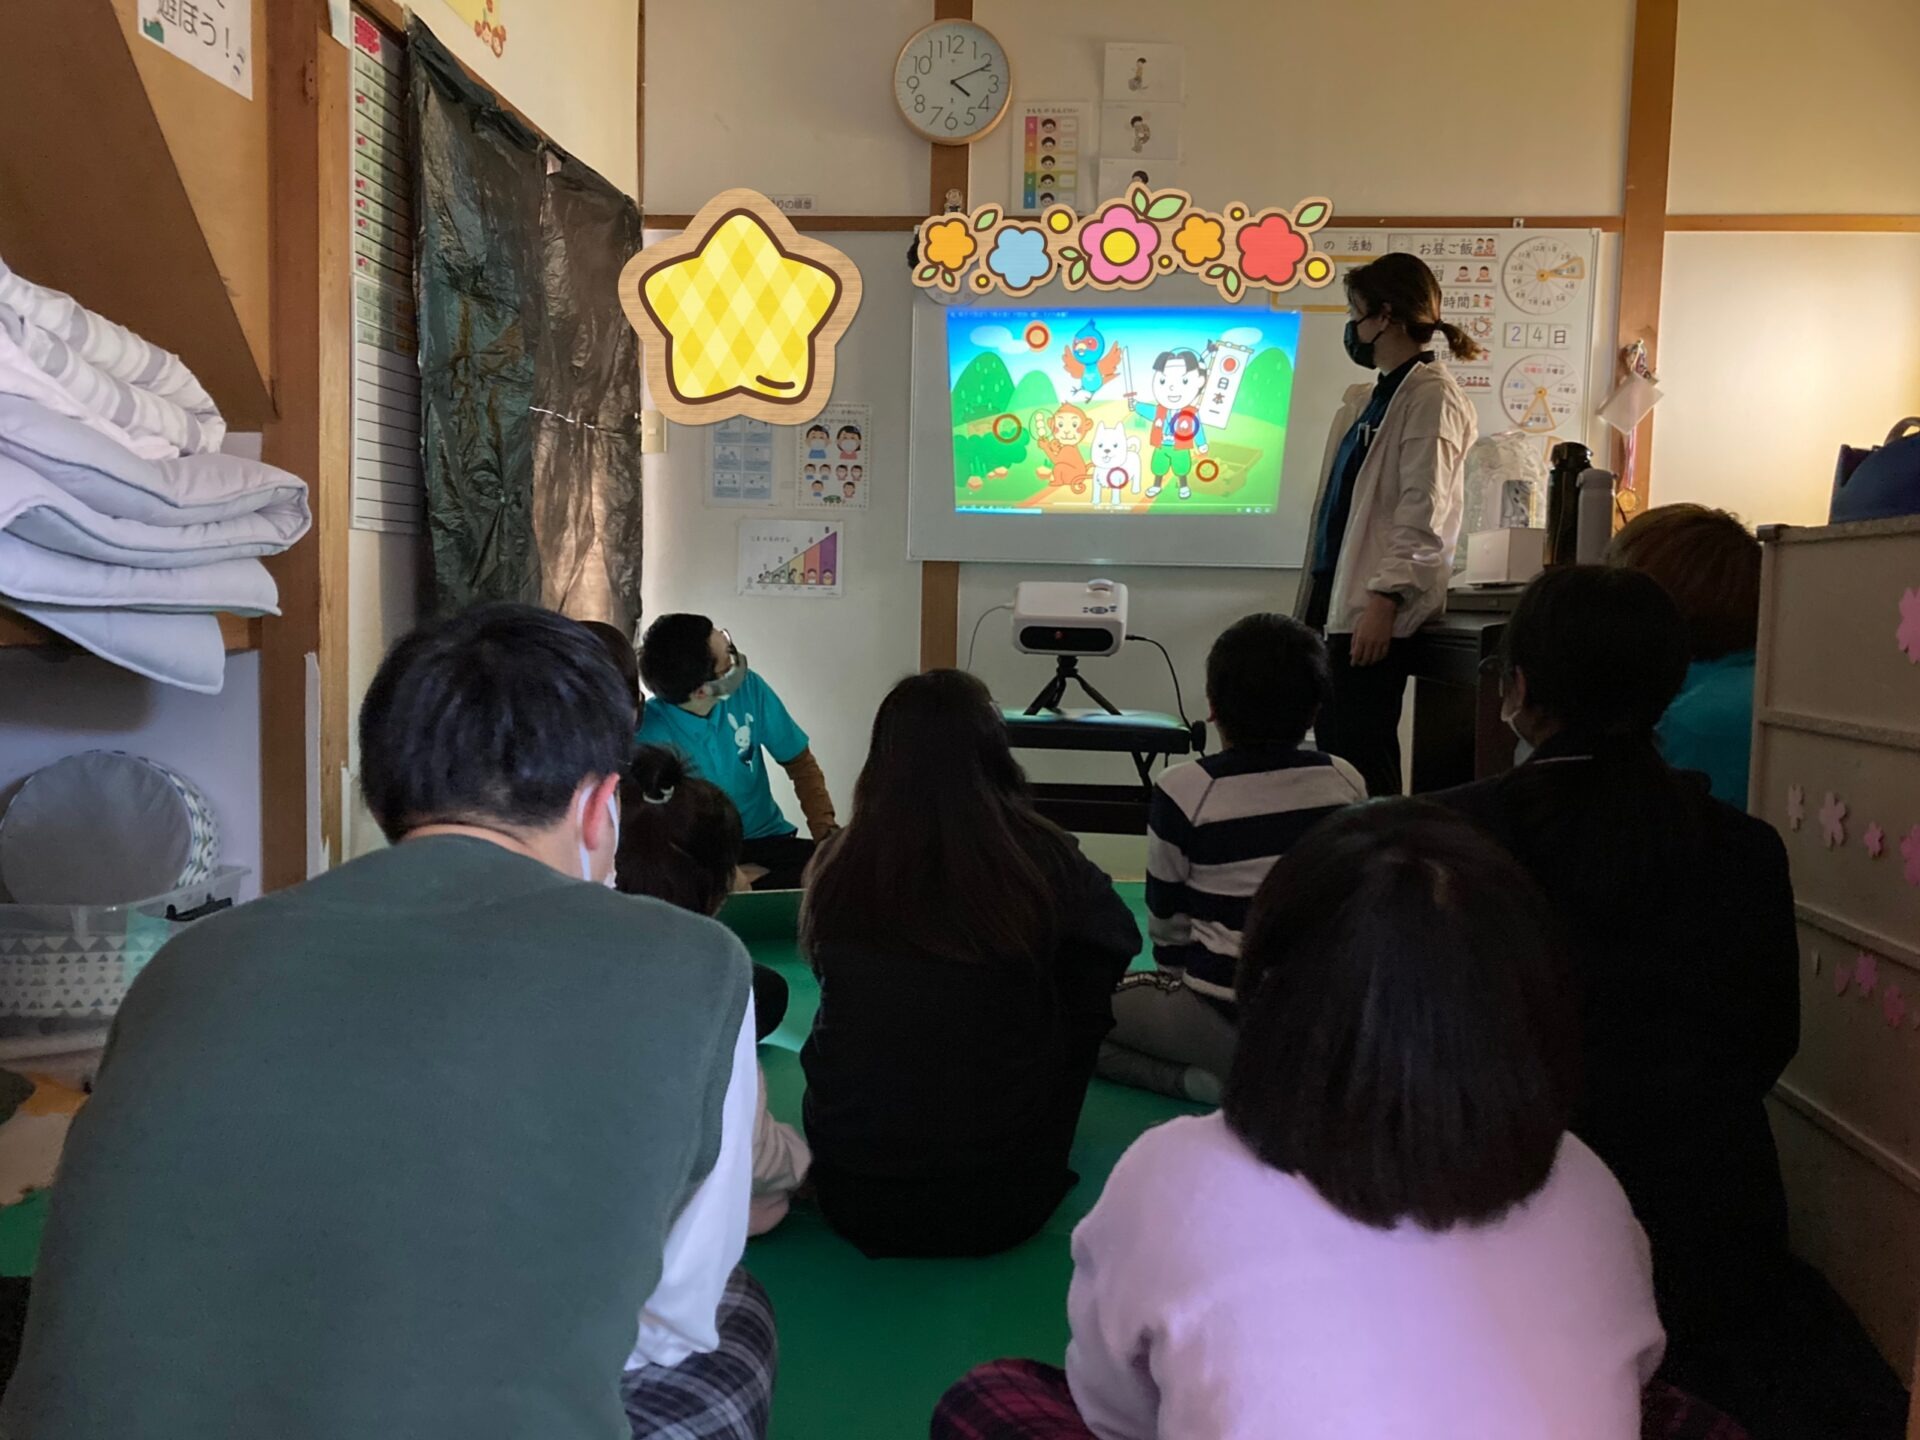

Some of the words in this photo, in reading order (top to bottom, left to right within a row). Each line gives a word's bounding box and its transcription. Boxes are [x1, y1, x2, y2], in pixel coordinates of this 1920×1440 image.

[928, 40, 943, 59] 11
[946, 35, 964, 54] 12
[913, 55, 932, 75] 10
[906, 75, 920, 94] 9
[988, 74, 1000, 94] 3
[914, 94, 926, 113] 8
[977, 94, 991, 112] 4
[929, 106, 944, 126] 7
[944, 111, 958, 131] 6
[963, 106, 976, 126] 5
[1324, 240, 1335, 250] の
[1348, 239, 1372, 252] 活動
[1419, 242, 1473, 256] お昼ご飯
[1208, 377, 1230, 415] 日本一
